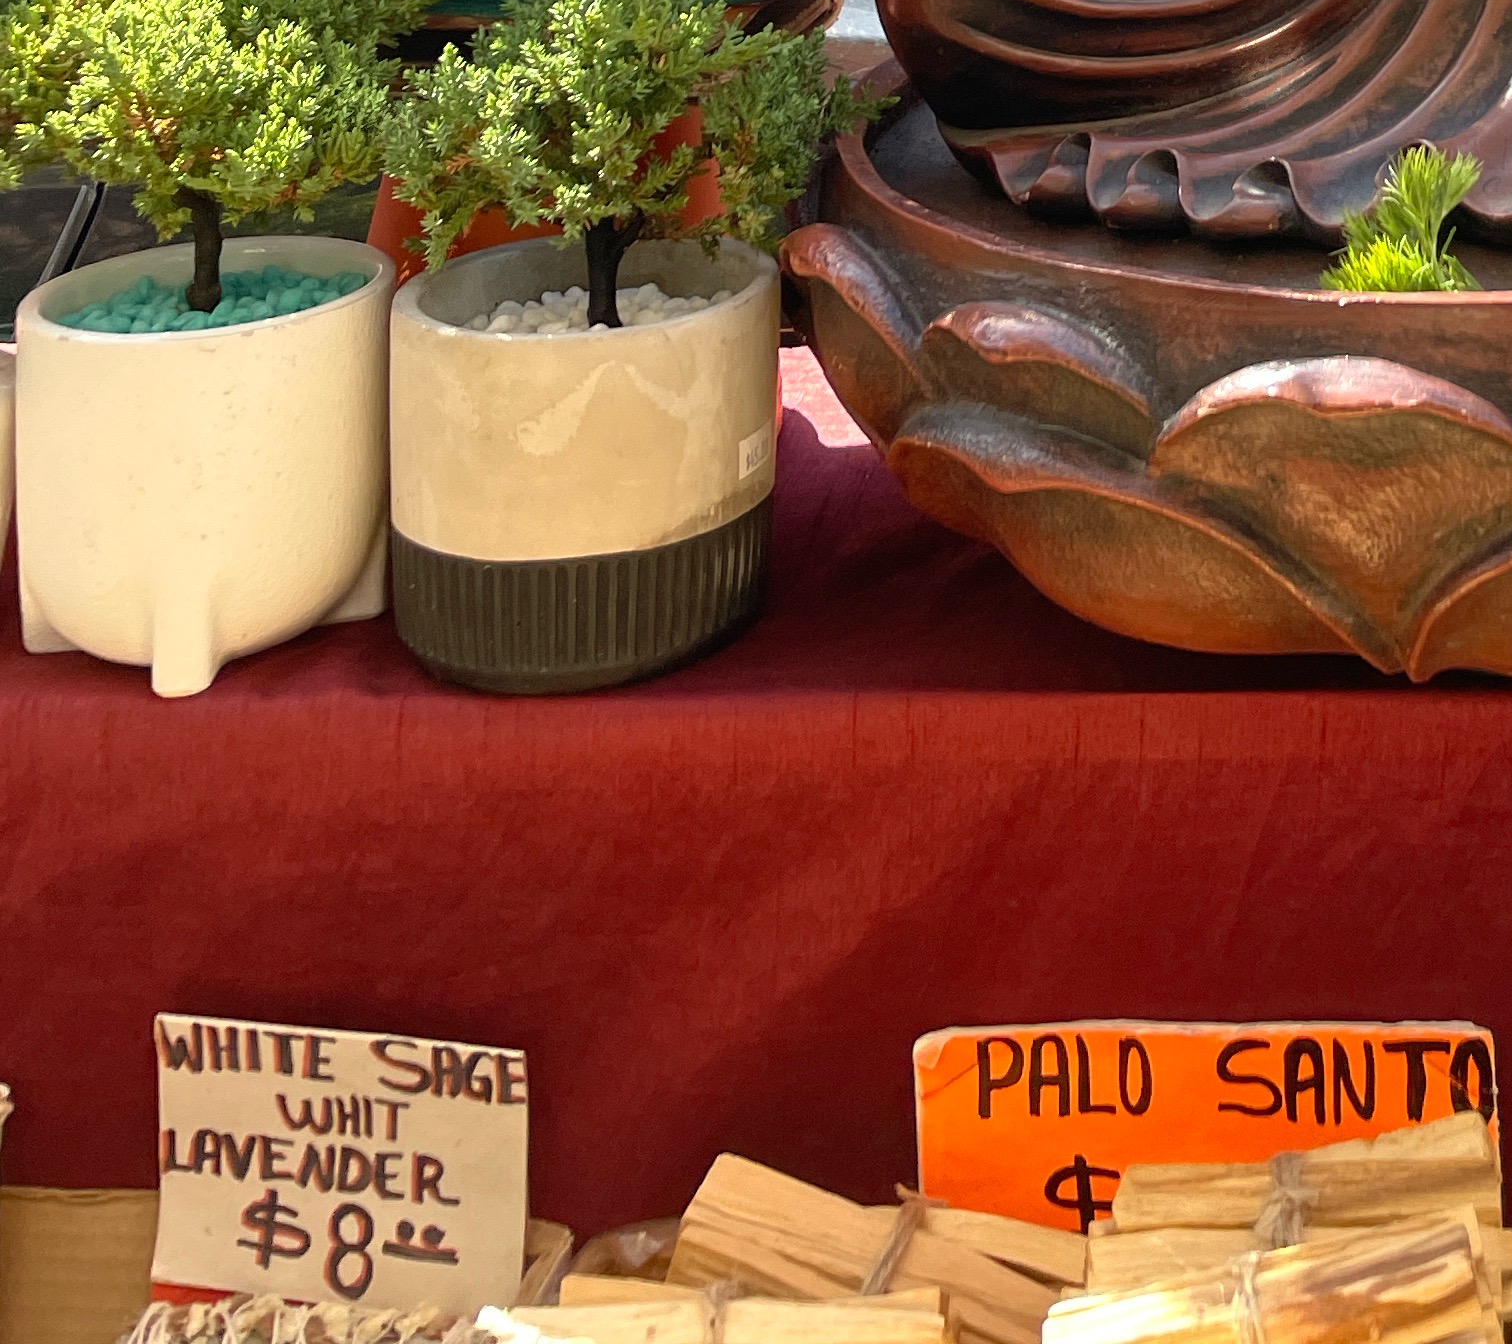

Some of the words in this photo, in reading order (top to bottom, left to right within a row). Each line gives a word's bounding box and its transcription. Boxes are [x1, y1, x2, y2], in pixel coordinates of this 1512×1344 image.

[157, 1019, 336, 1082] WHITE
[371, 1039, 526, 1104] SAGE
[977, 1034, 1153, 1118] PALO
[1216, 1037, 1496, 1124] SANTO
[276, 1094, 410, 1141] WHIT
[162, 1128, 461, 1205] LAVENDER
